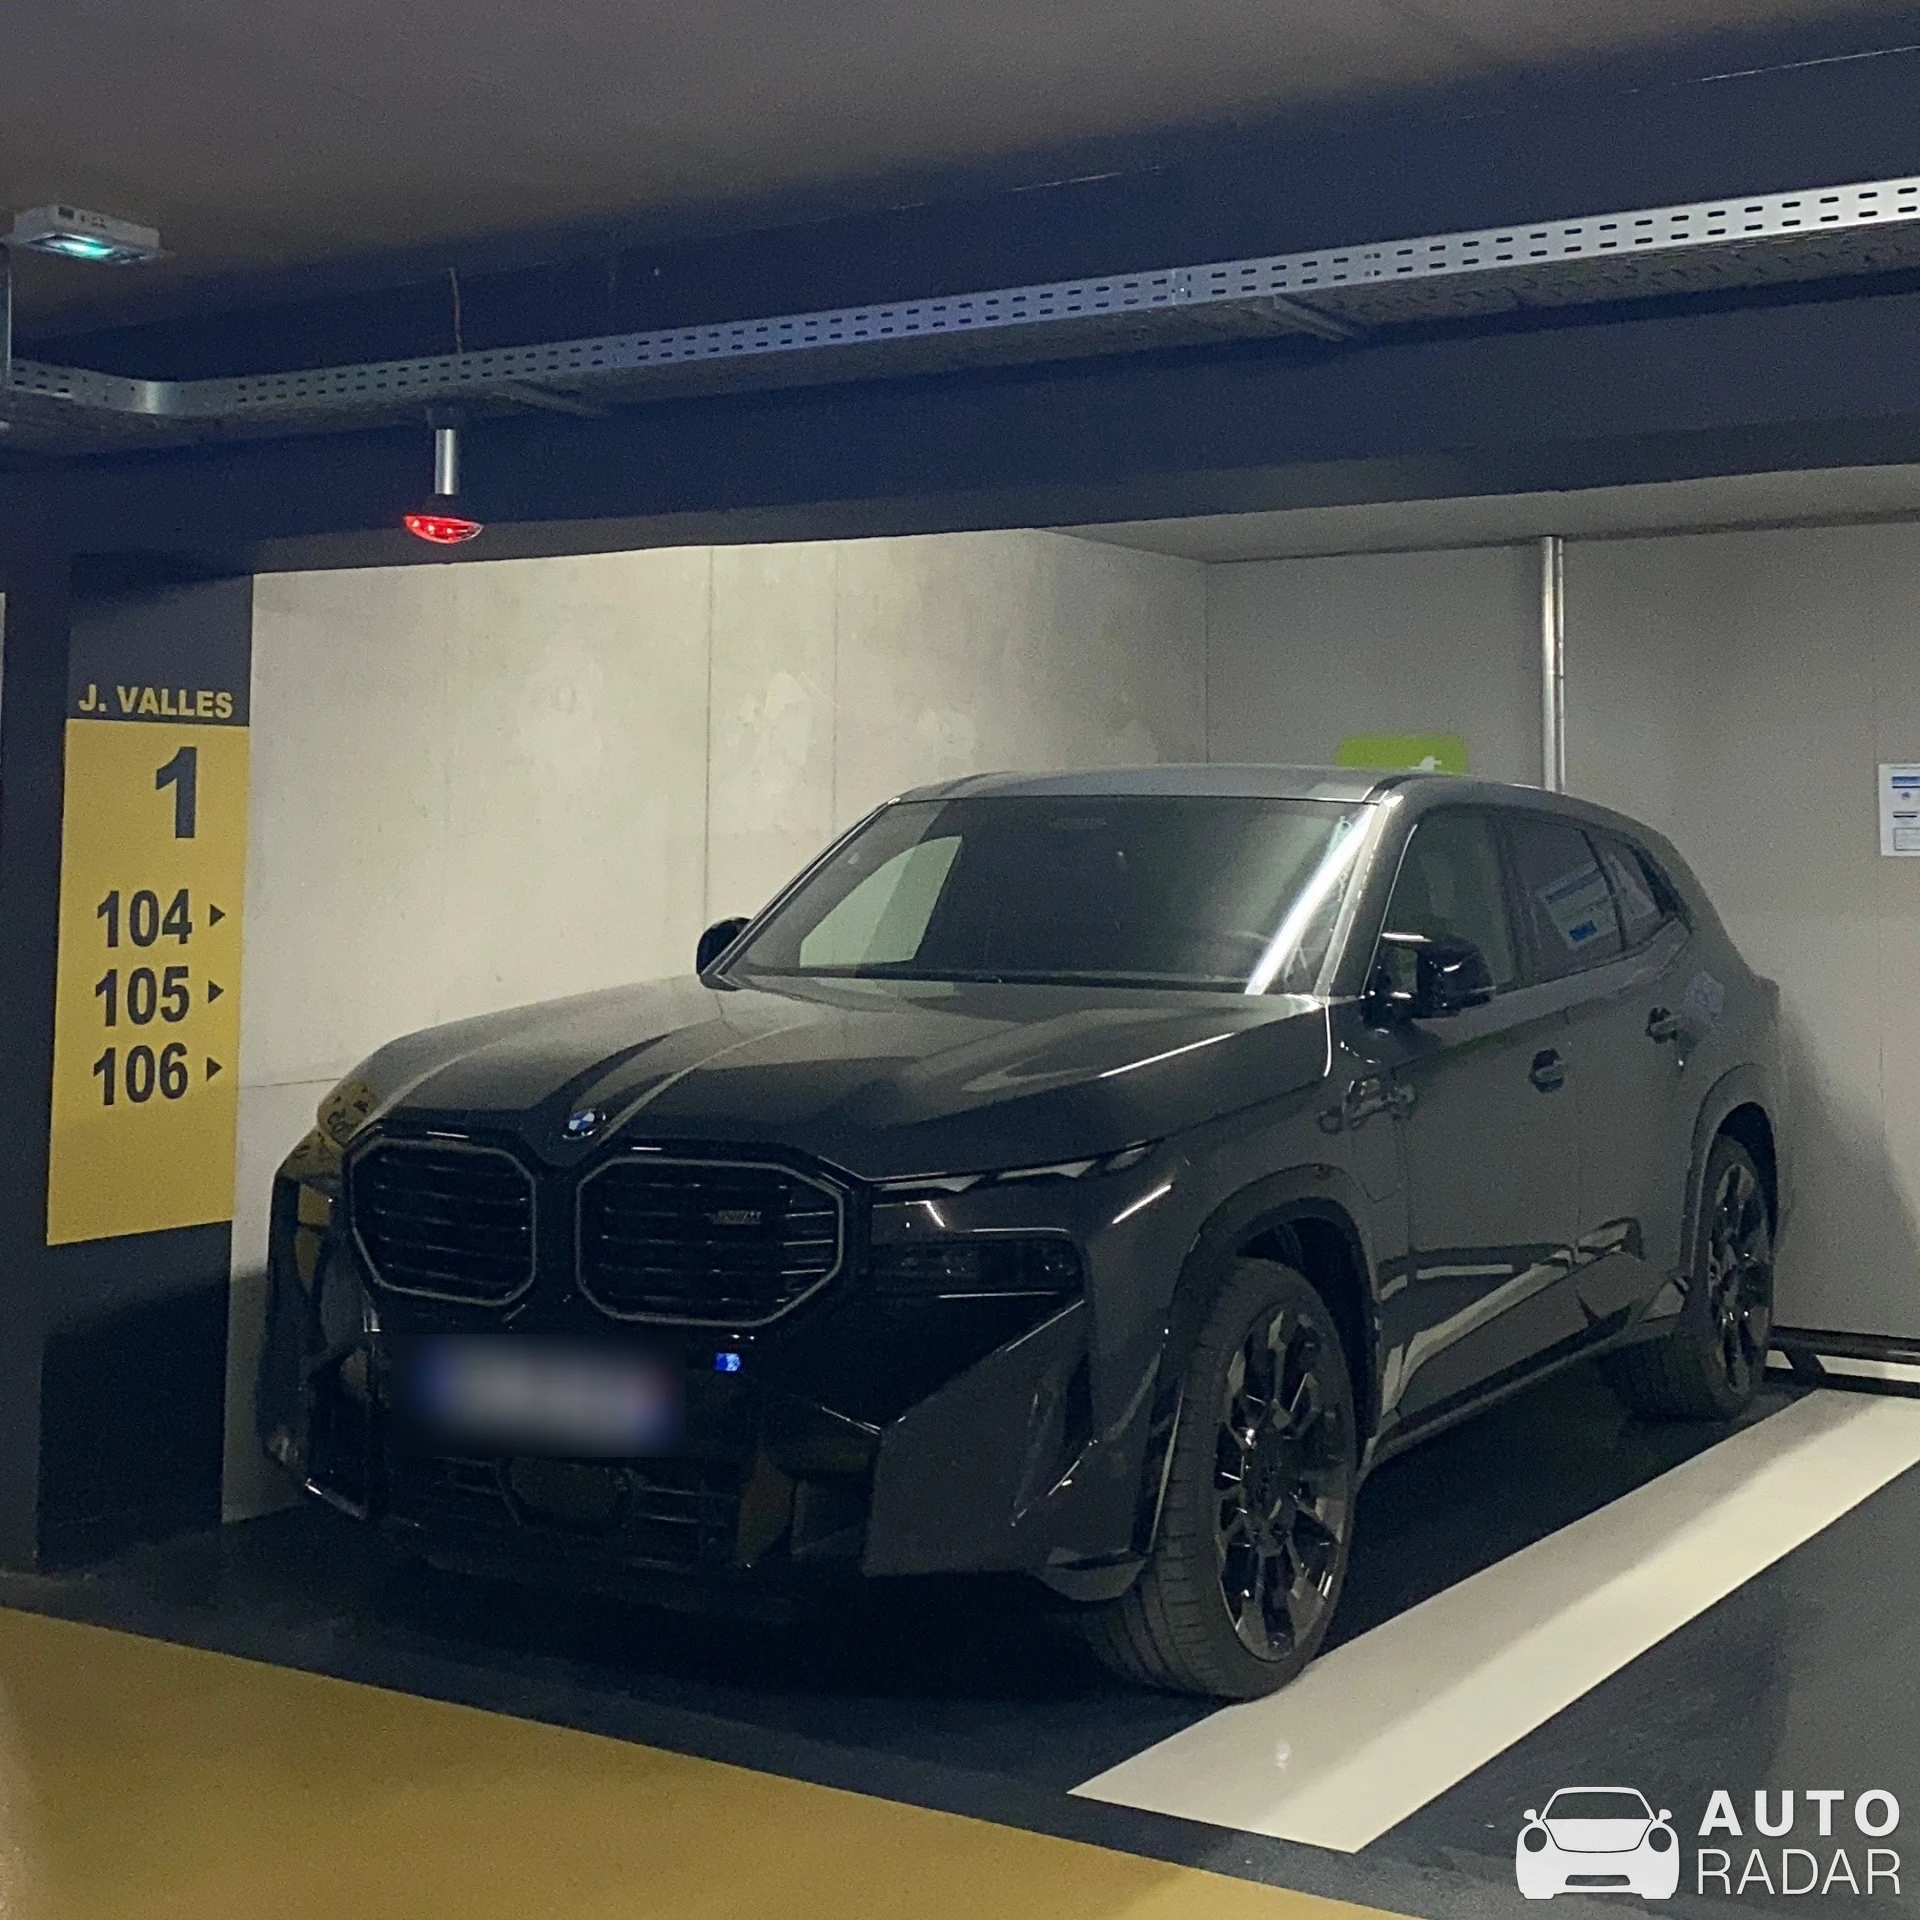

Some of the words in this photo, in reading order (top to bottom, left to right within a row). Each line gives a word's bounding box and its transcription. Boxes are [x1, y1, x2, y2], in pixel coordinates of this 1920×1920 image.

[79, 684, 107, 712] J.
[117, 685, 233, 719] VALLES
[156, 746, 197, 839] 1
[97, 888, 193, 948] 104
[95, 966, 190, 1027] 105
[93, 1042, 189, 1106] 106
